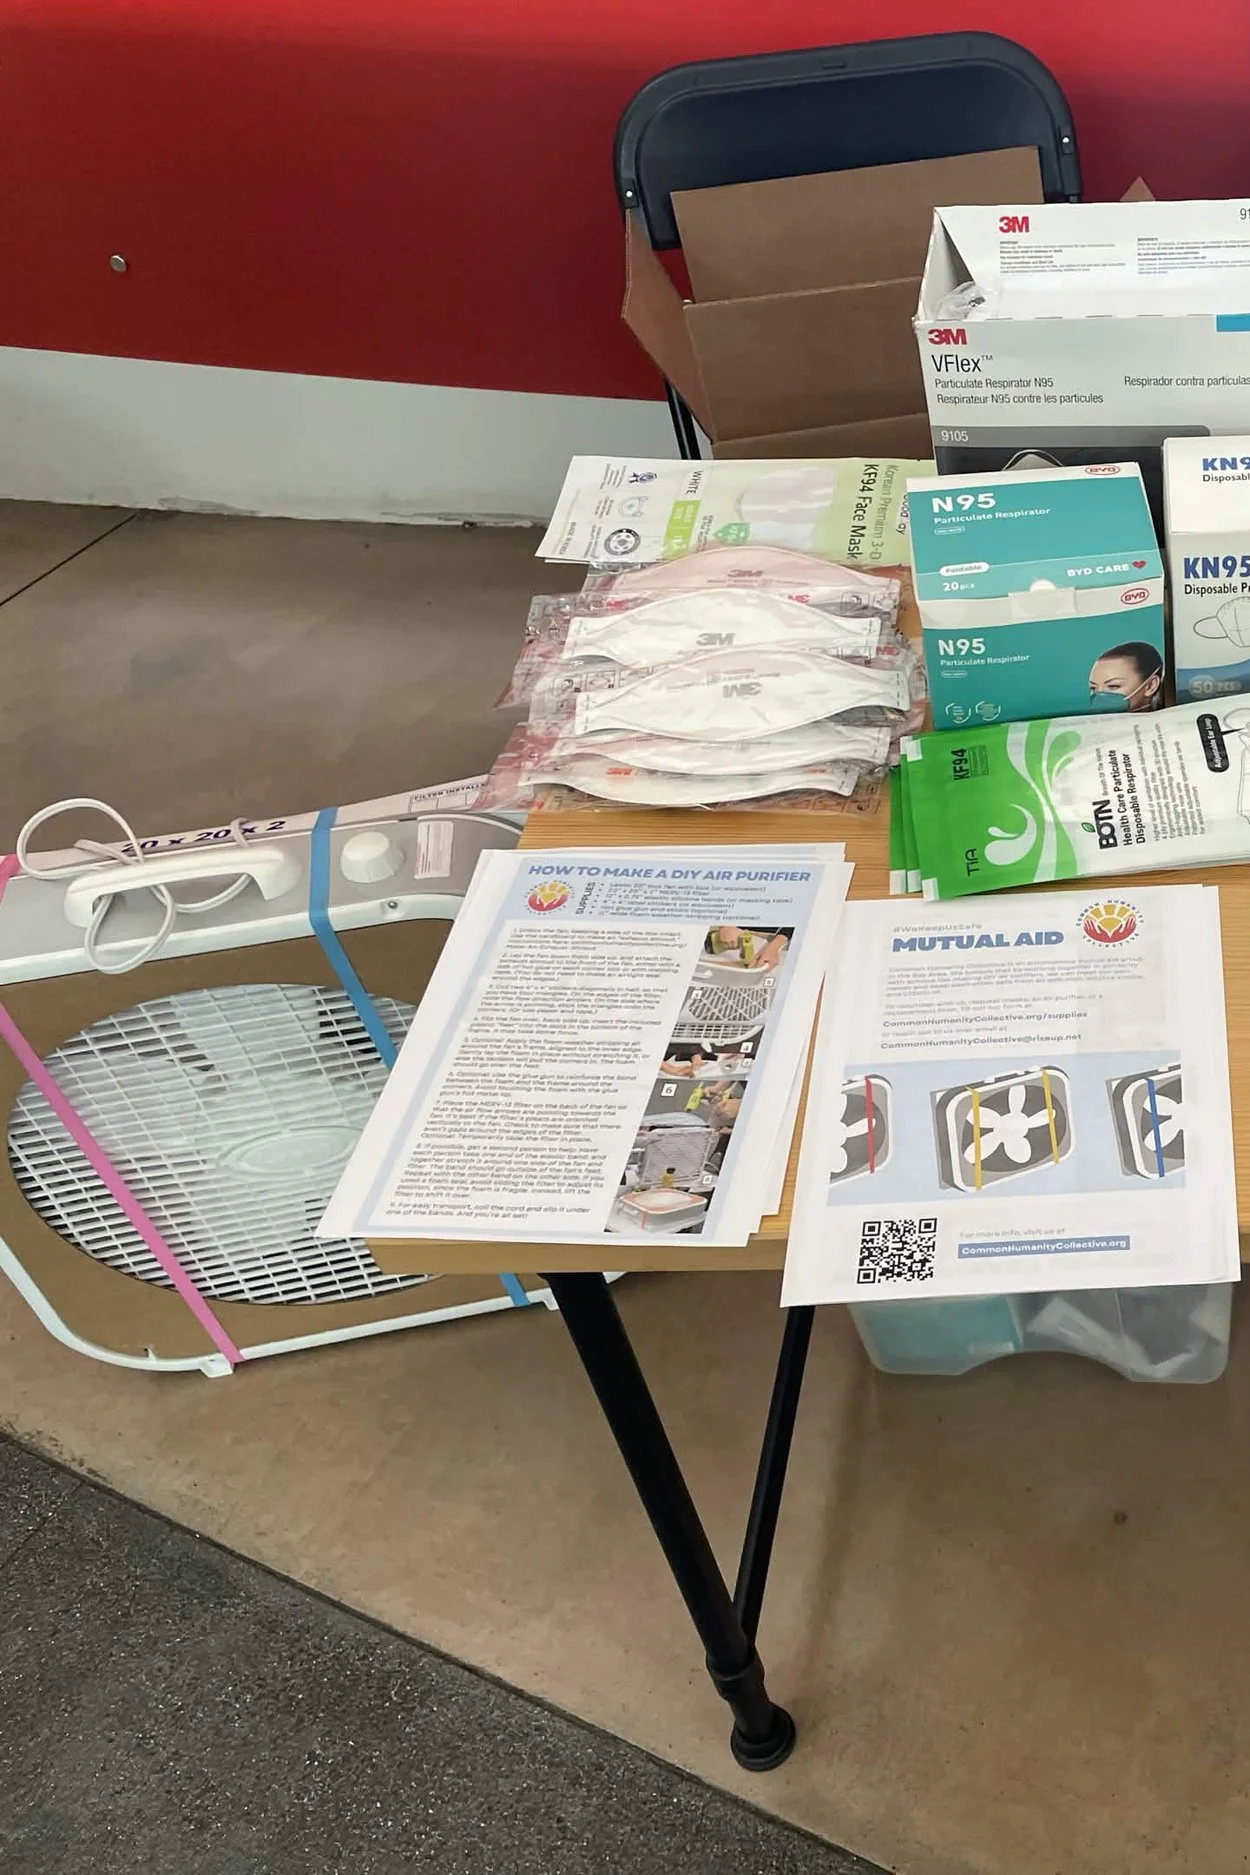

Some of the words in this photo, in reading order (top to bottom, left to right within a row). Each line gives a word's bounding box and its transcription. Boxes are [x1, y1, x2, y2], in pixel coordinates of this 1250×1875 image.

[999, 216, 1030, 233] 3M
[928, 328, 967, 346] 3M
[934, 377, 983, 390] Particulate
[985, 376, 1032, 390] Respirator
[1034, 376, 1054, 388] N95
[937, 393, 989, 406] Respirateur
[991, 393, 1011, 404] N95
[1012, 394, 1042, 404] contre
[1043, 392, 1057, 403] les
[1059, 392, 1104, 404] particules
[941, 430, 969, 442] 9105
[686, 470, 703, 495] WHITE
[859, 464, 879, 493] KF94
[852, 496, 873, 521] Face
[931, 493, 997, 513] N95
[934, 511, 993, 525] Particulate
[995, 507, 1051, 519] Respirator
[846, 525, 867, 559] Mask
[1184, 582, 1238, 596] Disposable
[937, 637, 987, 656] N95
[940, 655, 985, 666] Particulate
[986, 653, 1030, 665] Respirator
[951, 748, 970, 781] KF94
[1108, 749, 1125, 792] Particulate
[1122, 753, 1138, 794] Respirator
[1117, 793, 1127, 813] Care
[1129, 795, 1146, 843] Disposable
[196, 829, 231, 842] 20
[266, 820, 287, 831] 2
[1119, 814, 1133, 846] Health
[528, 865, 575, 876] HOW
[577, 866, 601, 876] TO
[603, 868, 653, 879] MAKE
[655, 868, 668, 879] A
[670, 869, 701, 880] DIY
[703, 870, 732, 881] AIR
[735, 870, 811, 882] PURIFIER
[575, 881, 596, 915] SUPPLIES
[892, 934, 1011, 953] MUTUAL
[1013, 931, 1064, 947] AID
[882, 1011, 1088, 1027] CommonHumanityCollective.org/supplies
[881, 1033, 1082, 1049] CommonHumanityCollective@riseup.net
[961, 1239, 1127, 1255] CommonHumanityCollective.org
